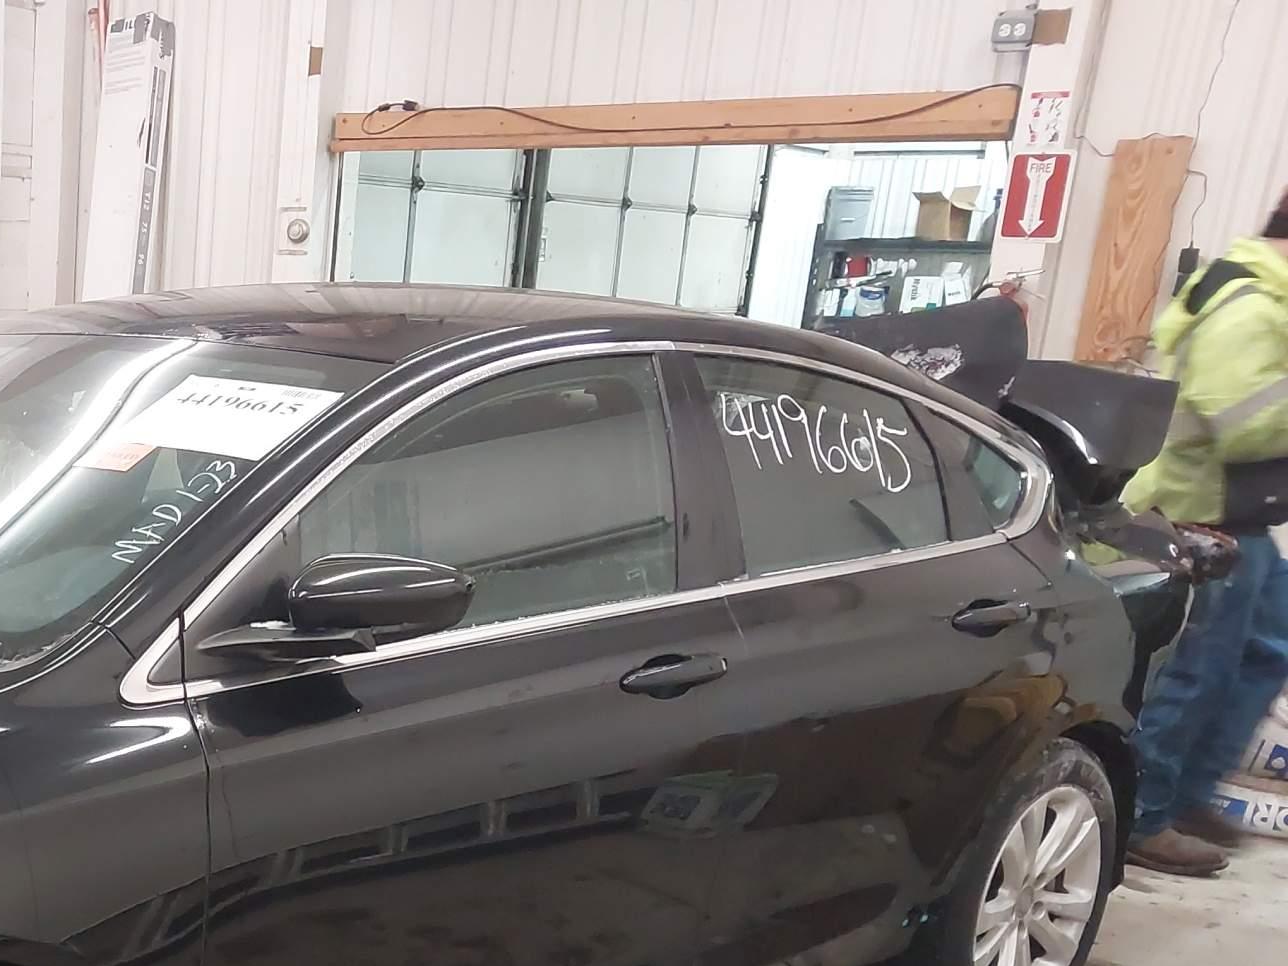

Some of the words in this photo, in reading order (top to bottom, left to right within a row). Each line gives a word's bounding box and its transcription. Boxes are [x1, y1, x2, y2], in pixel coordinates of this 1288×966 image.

[1029, 162, 1053, 174] FIRE
[177, 391, 305, 416] 44196615
[720, 393, 912, 493] 44196615
[111, 502, 183, 564] MAD
